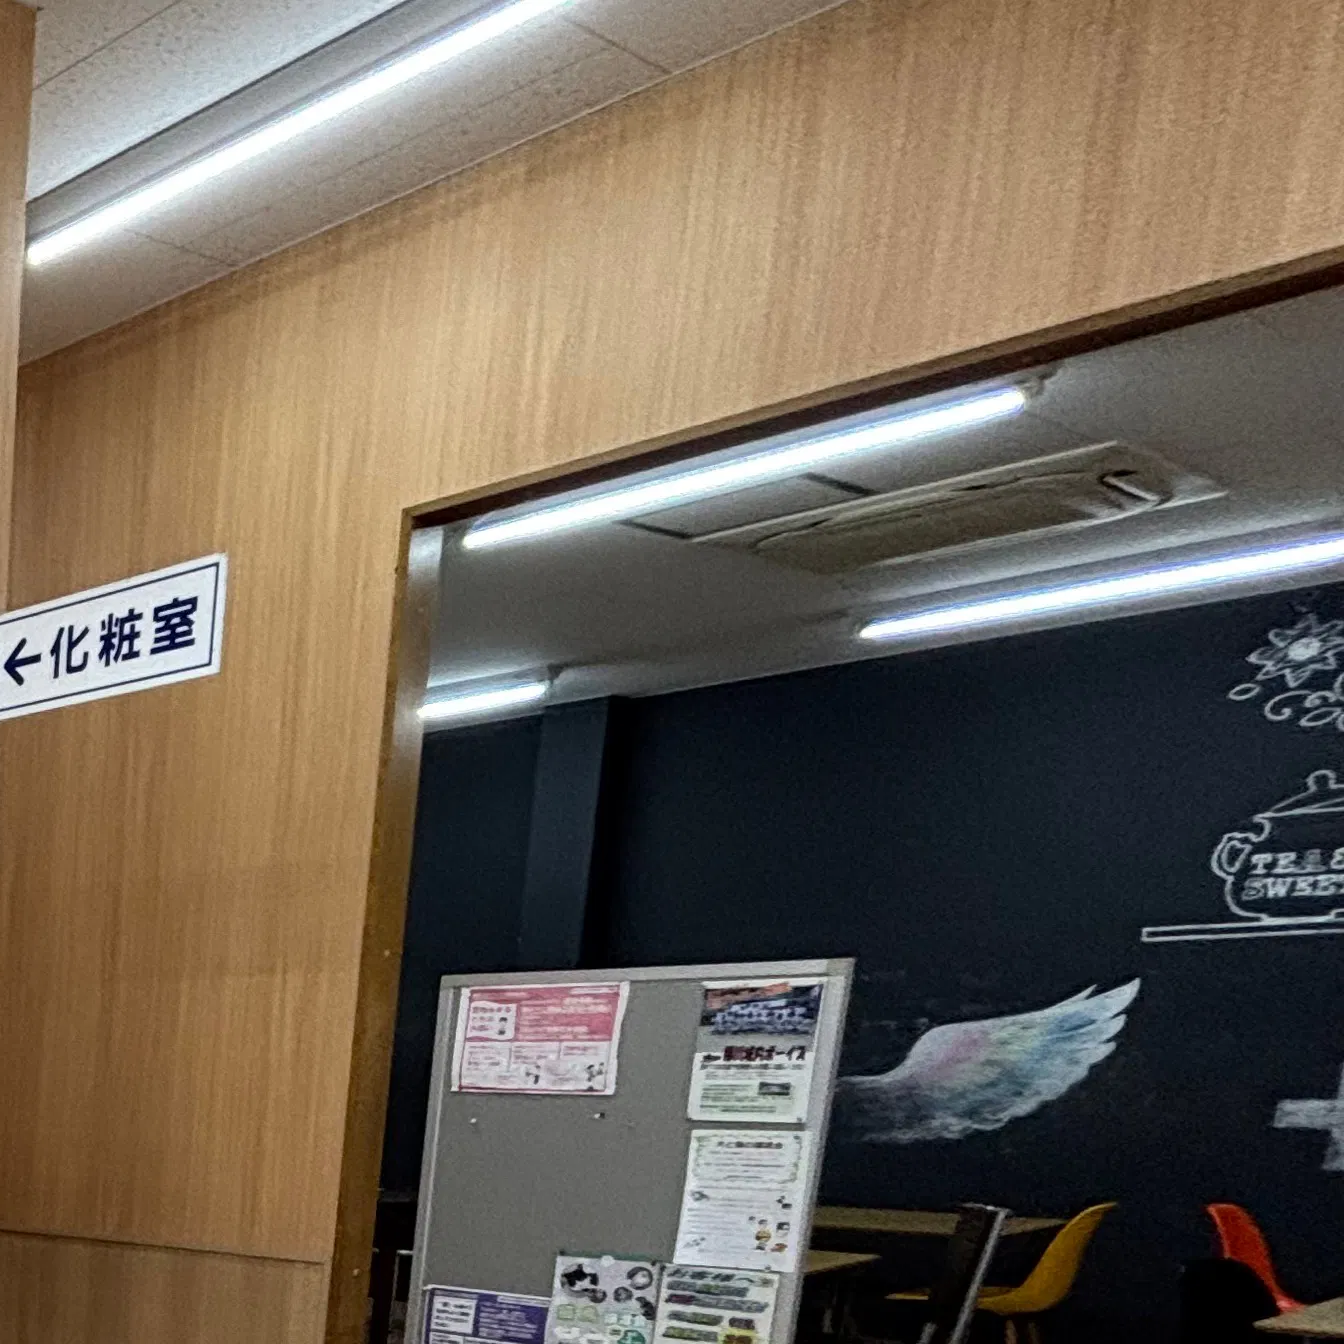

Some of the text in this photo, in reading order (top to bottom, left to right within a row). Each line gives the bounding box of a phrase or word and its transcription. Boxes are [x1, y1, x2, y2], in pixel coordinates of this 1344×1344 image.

[50, 596, 199, 679] 化粧室
[1249, 849, 1328, 874] TEA
